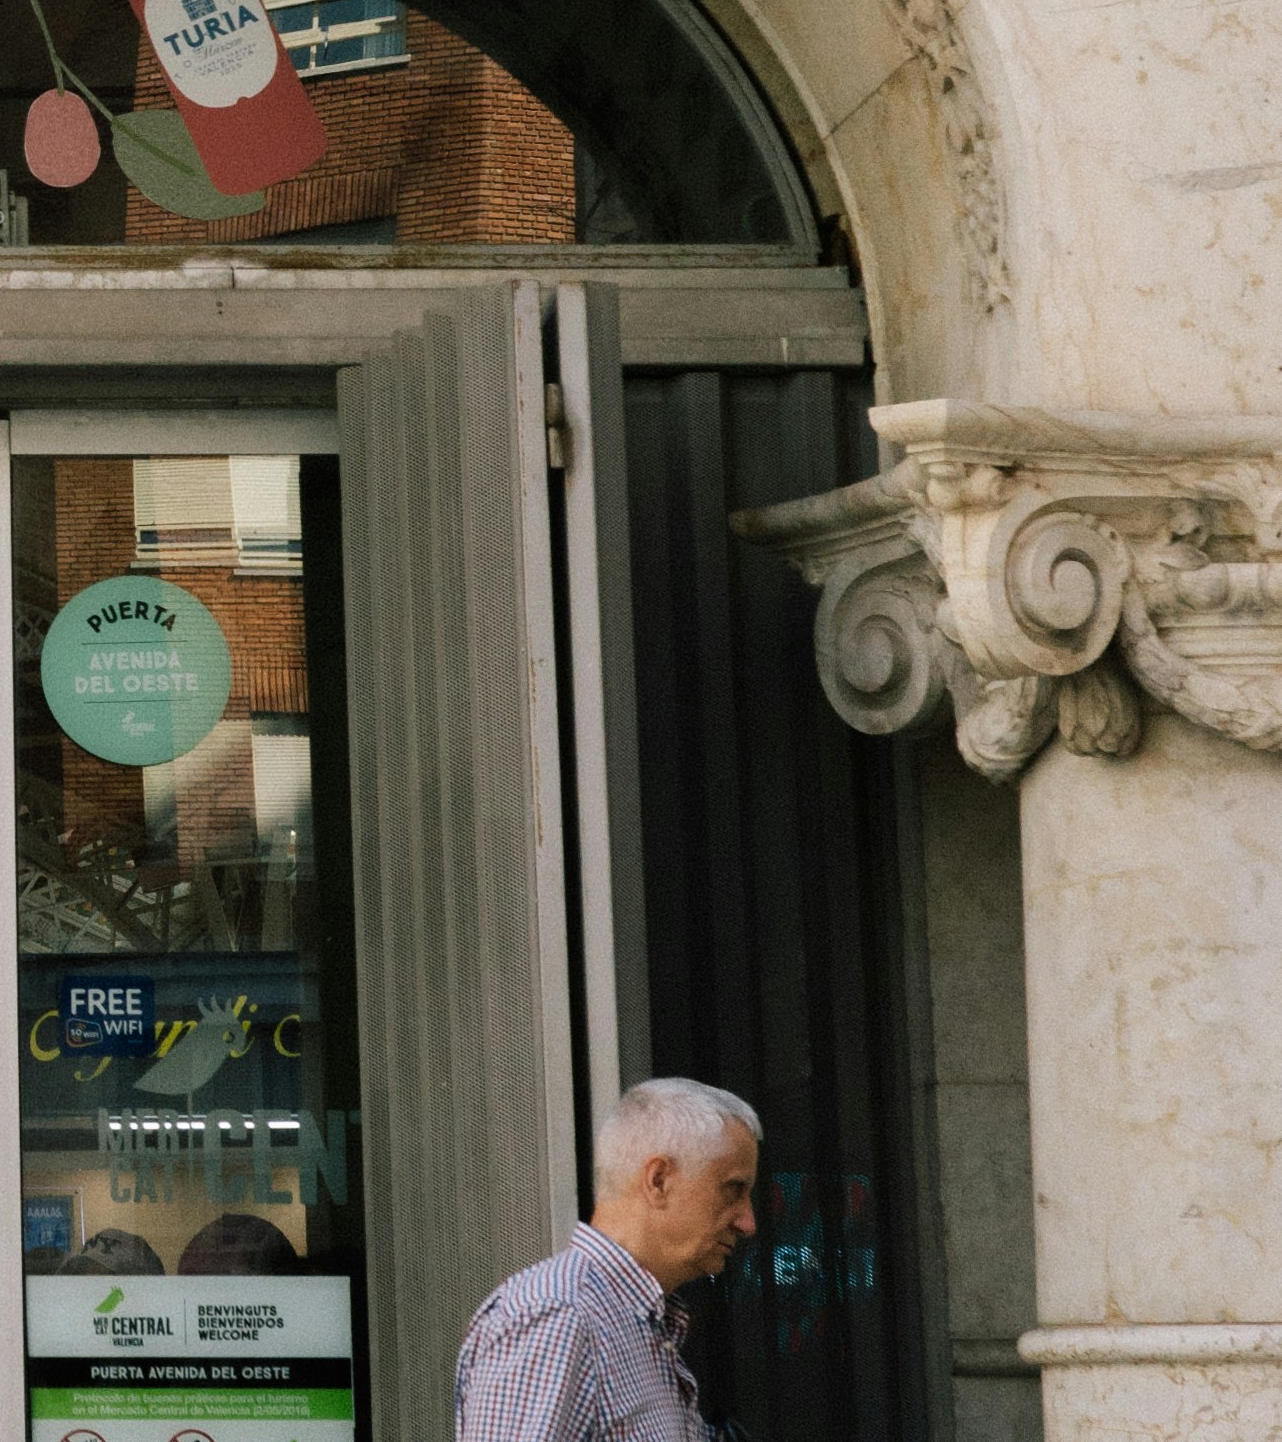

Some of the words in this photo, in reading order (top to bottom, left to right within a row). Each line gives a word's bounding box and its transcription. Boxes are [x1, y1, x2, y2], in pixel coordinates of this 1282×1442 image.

[163, 4, 259, 56] TURIA
[86, 601, 177, 633] PUERTA
[88, 651, 181, 671] AVENIDA
[74, 675, 116, 694] DEL
[122, 673, 199, 693] OESTE
[70, 987, 143, 1016] FREE
[103, 1019, 144, 1036] WIFI
[197, 1305, 277, 1316] BENVINGUTS
[112, 1317, 174, 1336] CENTRAL
[197, 1317, 285, 1328] BIENVENIDOS
[198, 1330, 259, 1341] WELCOME
[91, 1367, 144, 1379] PUERTA
[149, 1367, 207, 1379] AVENIDA
[211, 1367, 237, 1379] DEL
[242, 1367, 291, 1379] OESTE
[150, 1405, 187, 1415] Central
[190, 1406, 204, 1415] de
